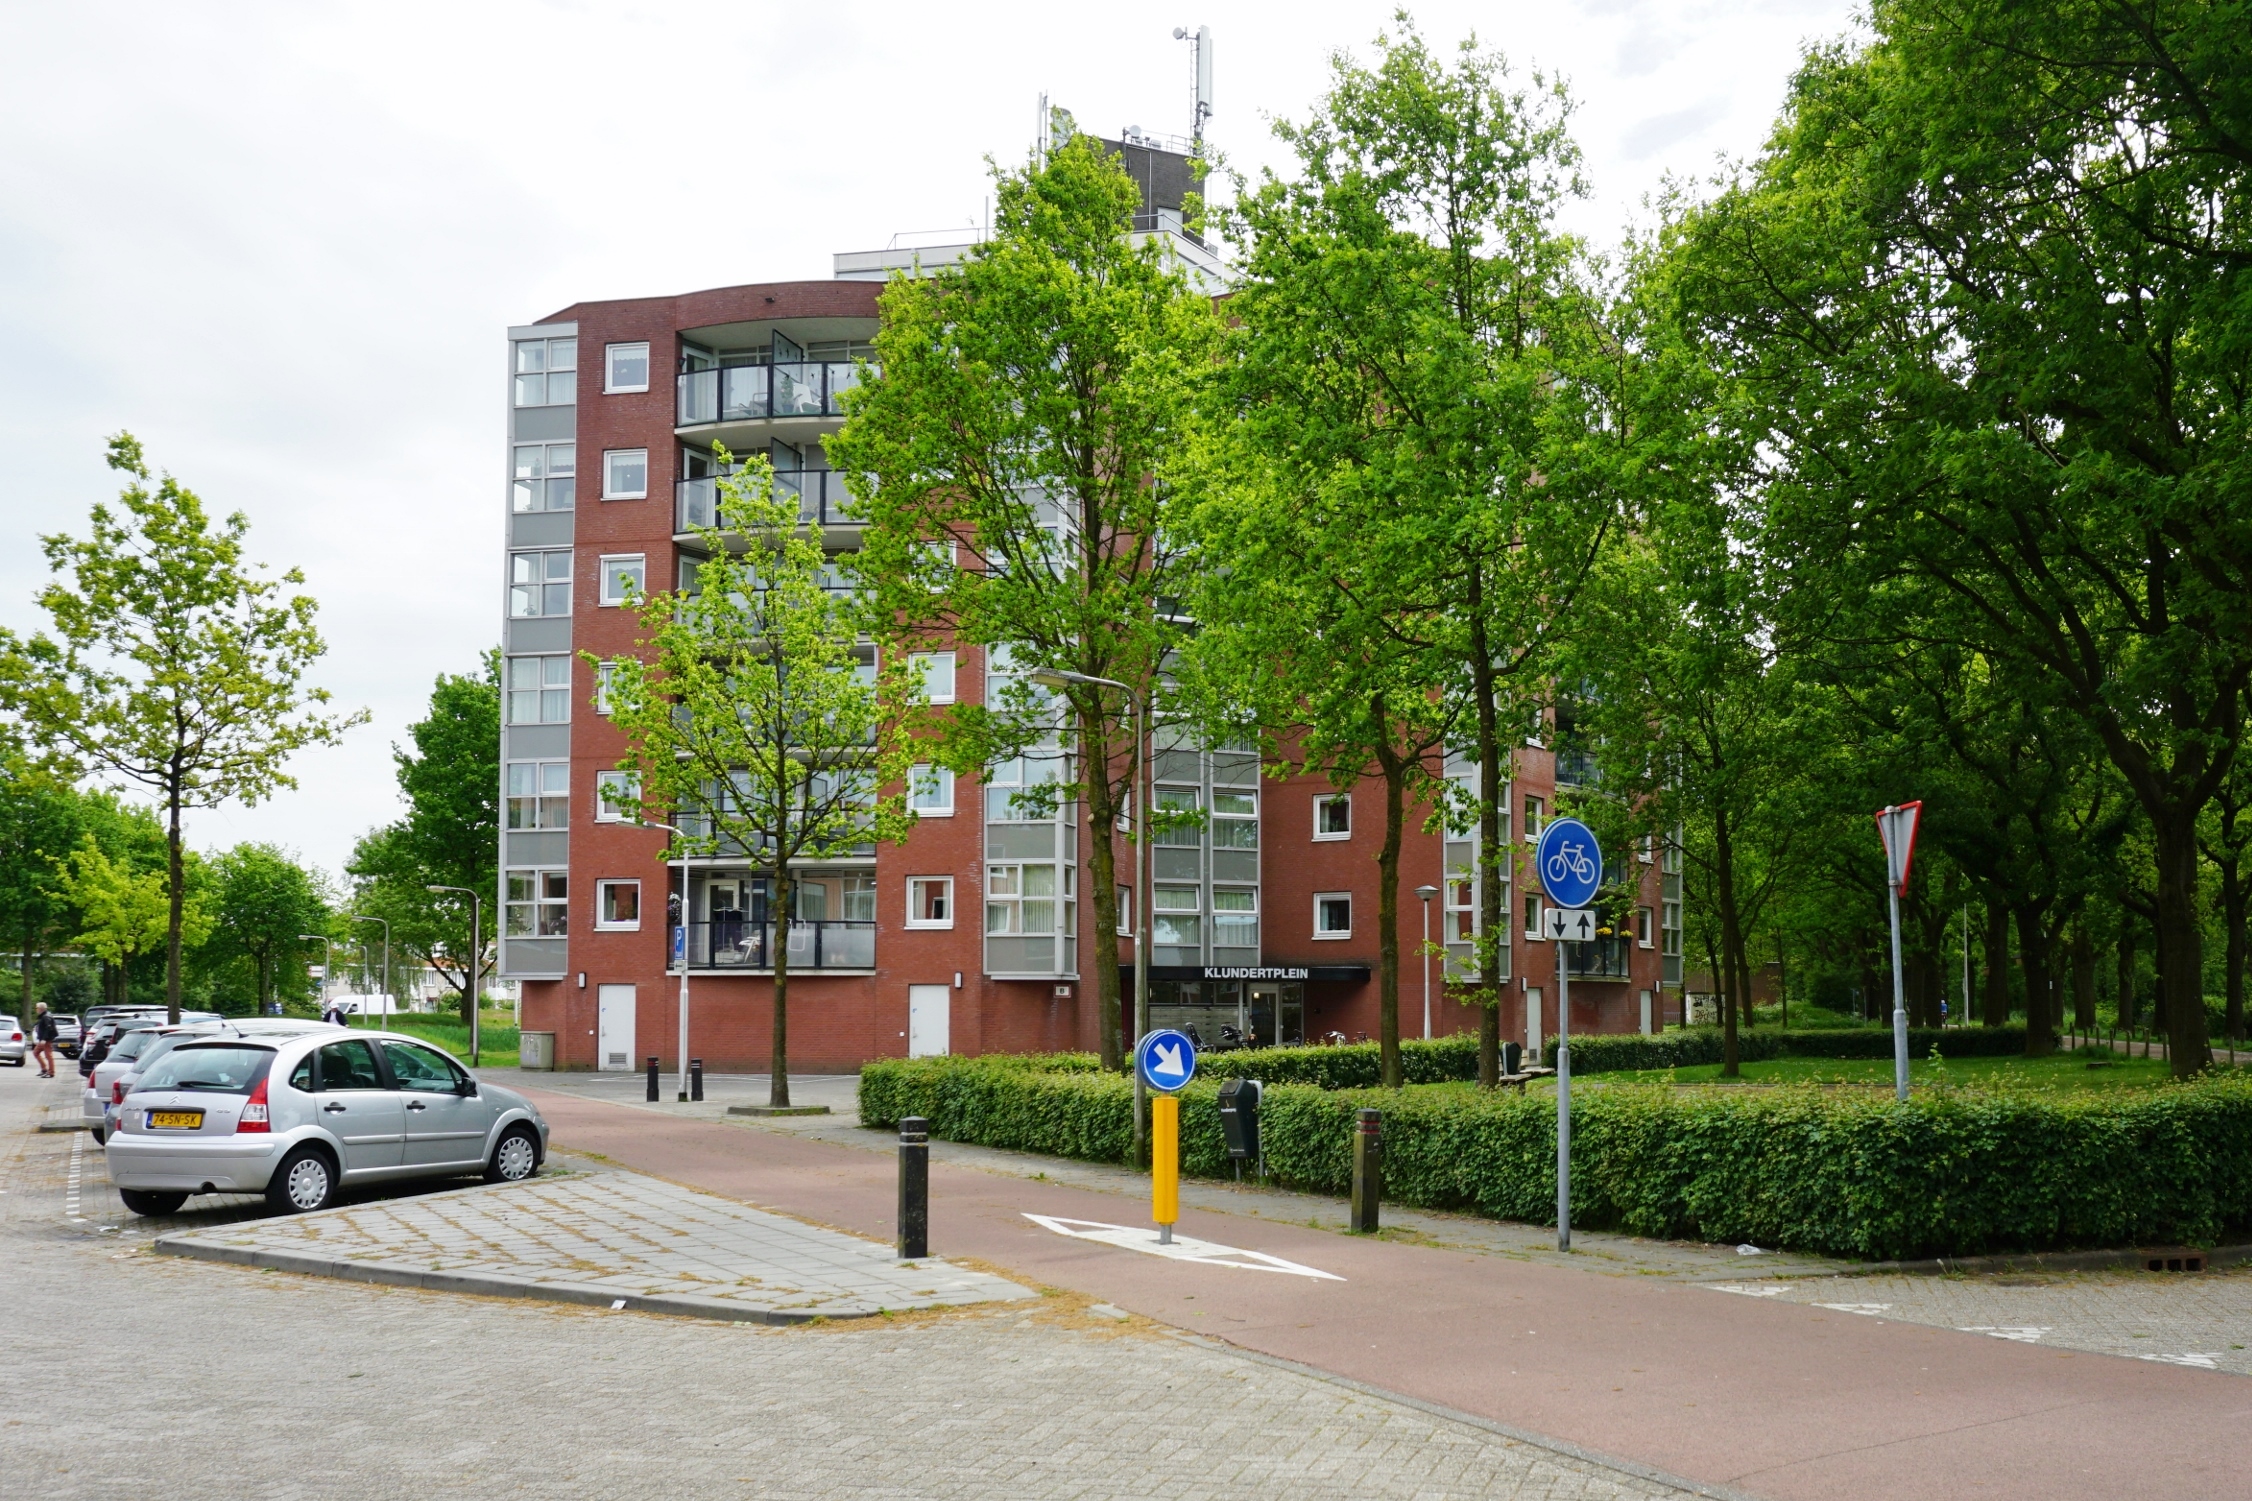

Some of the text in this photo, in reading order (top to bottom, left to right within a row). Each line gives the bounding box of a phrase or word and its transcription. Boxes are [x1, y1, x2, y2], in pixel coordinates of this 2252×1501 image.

[677, 929, 682, 946] P
[1204, 967, 1308, 979] KLUNDERTPLEIN
[153, 1114, 197, 1125] 74-SN-SK
